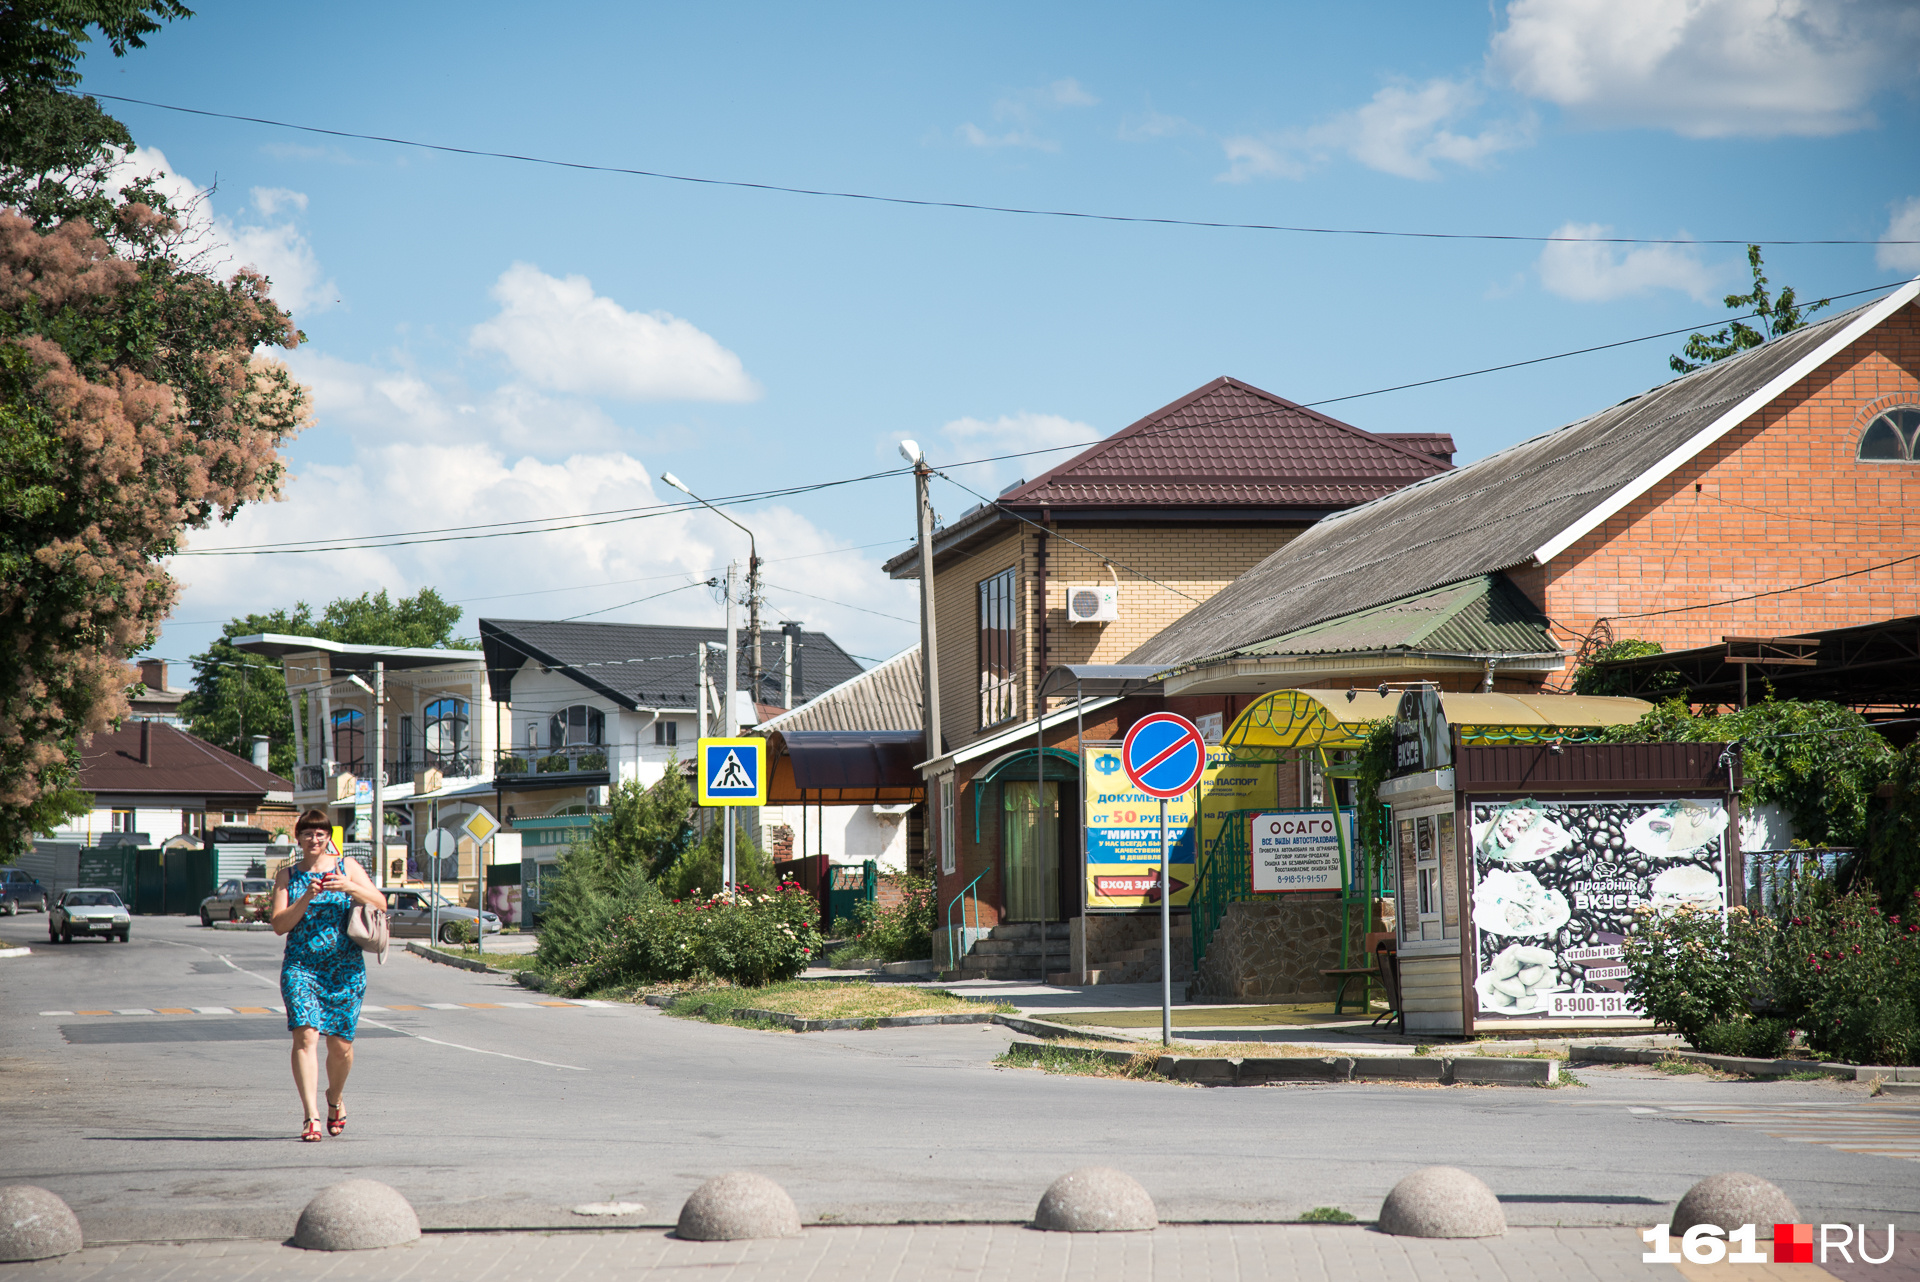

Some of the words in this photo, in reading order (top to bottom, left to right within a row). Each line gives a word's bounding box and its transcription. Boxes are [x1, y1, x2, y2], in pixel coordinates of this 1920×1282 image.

[1216, 778, 1258, 786] ПАСПОРТ
[1098, 794, 1183, 804] ДОКУМЕЫ
[1093, 815, 1109, 823] ОТ
[1113, 811, 1137, 823] 50
[1270, 820, 1332, 834] ОСАГО
[1101, 830, 1183, 840] “МИНУТА”
[1275, 837, 1290, 845] ВИДЫ
[1278, 875, 1328, 883] 8-918-51-91-517
[1101, 881, 1133, 890] ВХОД
[1135, 881, 1171, 890] ЗДЕС
[1575, 880, 1637, 892] Праздник
[1567, 947, 1600, 959] чтобы
[1603, 947, 1615, 956] не
[1554, 998, 1633, 1012] 8-900-131-
